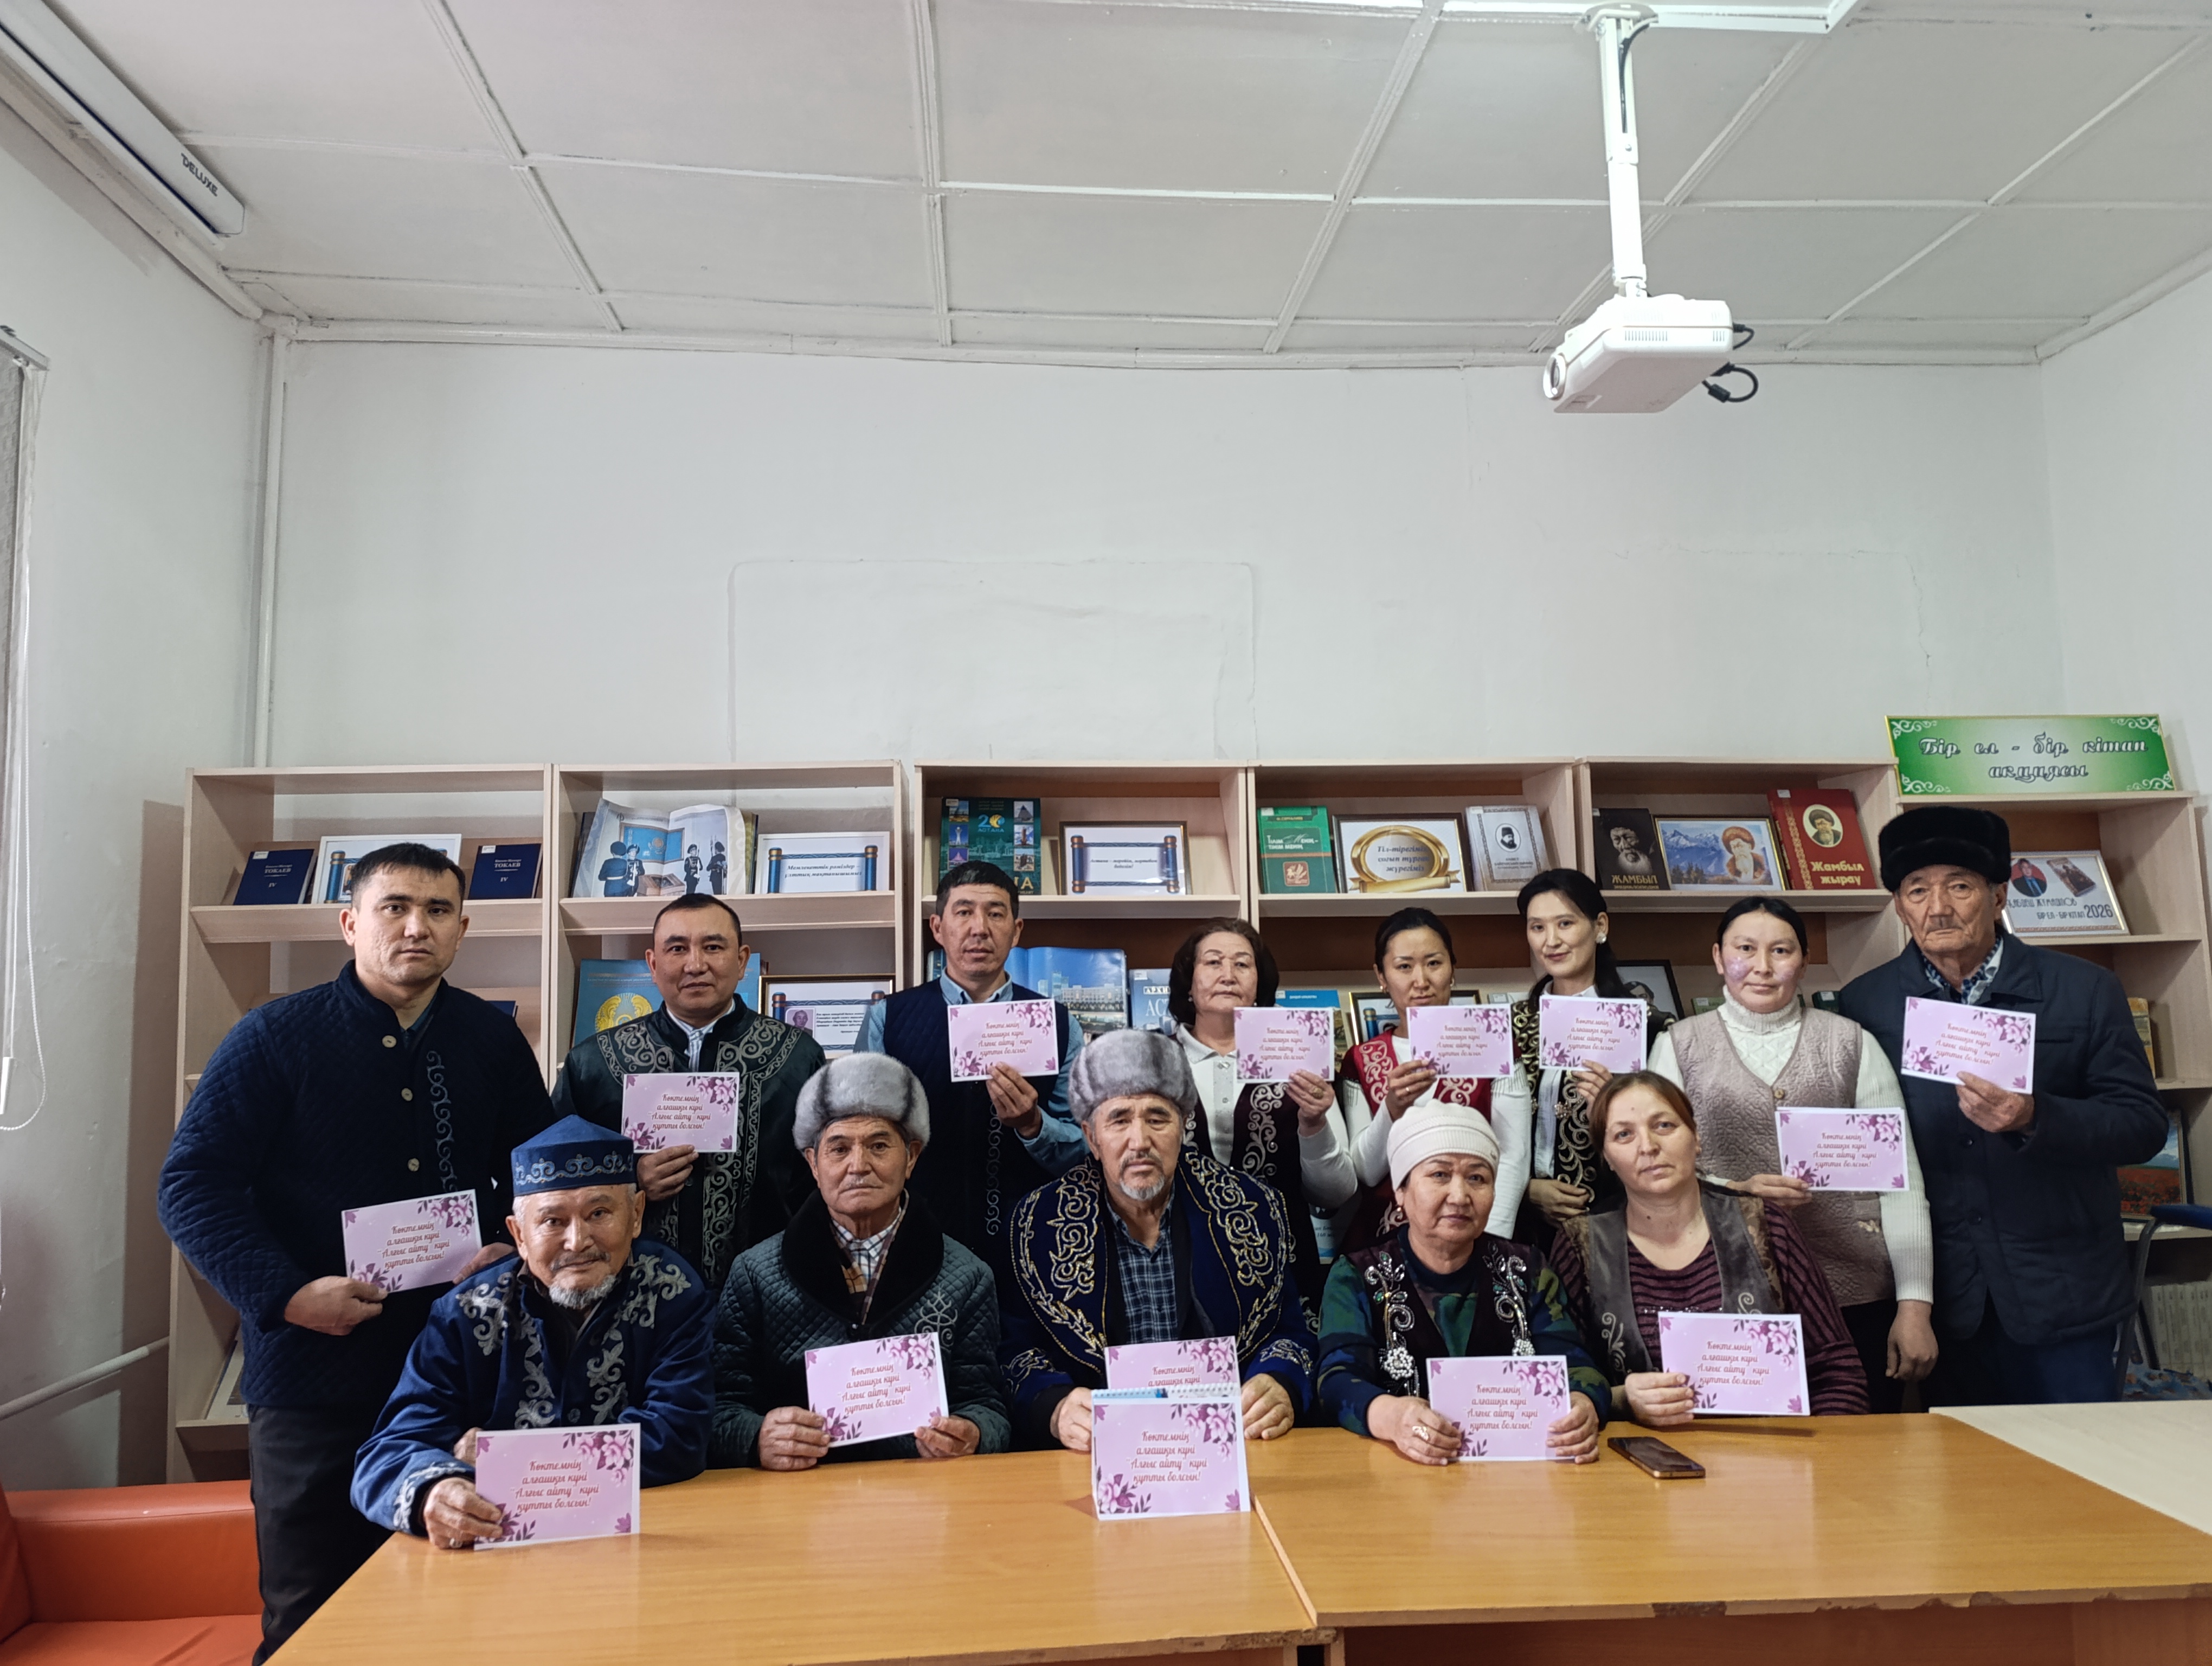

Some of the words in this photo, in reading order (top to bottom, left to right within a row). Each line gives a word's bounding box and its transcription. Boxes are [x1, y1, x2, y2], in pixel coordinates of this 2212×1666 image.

[181, 152, 218, 197] DELUXE
[1918, 738, 1961, 758] Бір
[1974, 742, 1999, 754] ел
[2033, 731, 2069, 758] бір
[2082, 736, 2149, 753] кітап
[1988, 765, 2089, 783] акциясы
[1810, 861, 1864, 872] Жамбыл
[1612, 875, 1657, 883] ЖАМБЫЛ
[1820, 876, 1861, 886] жырау
[2084, 904, 2113, 918] 2026
[662, 1094, 699, 1103] Көктемнің
[657, 1104, 688, 1113] алғашқы
[652, 1123, 678, 1131] құтты
[391, 1222, 434, 1234] Көктемнің
[387, 1235, 423, 1246] алғашқы
[423, 1231, 440, 1241] күні
[434, 1239, 450, 1249] күні
[384, 1257, 415, 1270] құтты
[415, 1251, 445, 1263] болсын!
[1707, 1341, 1752, 1353] Көктемнің
[1702, 1354, 1739, 1363] алғашқы
[1740, 1355, 1758, 1364] күні
[851, 1363, 894, 1376] Көктемнің
[1153, 1366, 1195, 1375] Көктемнің
[1753, 1367, 1770, 1375] күні
[846, 1378, 882, 1389] алғашқы
[884, 1375, 900, 1383] күні
[1148, 1377, 1183, 1387] алғашқы
[1185, 1376, 1200, 1385] күні
[1699, 1376, 1730, 1386] құтты
[1732, 1376, 1764, 1386] болсын!
[895, 1383, 911, 1394] күні
[1476, 1385, 1521, 1394] Көктемнің
[844, 1402, 874, 1415] құтты
[876, 1396, 905, 1408] болсын!
[1471, 1398, 1508, 1407] алғашқы
[1510, 1399, 1527, 1407] күні
[1521, 1409, 1538, 1419] күні
[1470, 1422, 1500, 1432] құтты
[1501, 1420, 1532, 1429] болсын!
[1142, 1432, 1189, 1441] Көктемнің
[1136, 1446, 1176, 1457] алғашқы
[1178, 1445, 1195, 1455] күні
[529, 1461, 582, 1471] Көктемнің
[1189, 1458, 1207, 1470] күні
[522, 1475, 566, 1486] алғашқы
[567, 1472, 587, 1483] күні
[1133, 1471, 1166, 1484] құтты
[1167, 1470, 1200, 1481] болсын!
[580, 1485, 599, 1495] күні
[517, 1502, 552, 1514] құтты
[554, 1498, 591, 1508] болсын!
